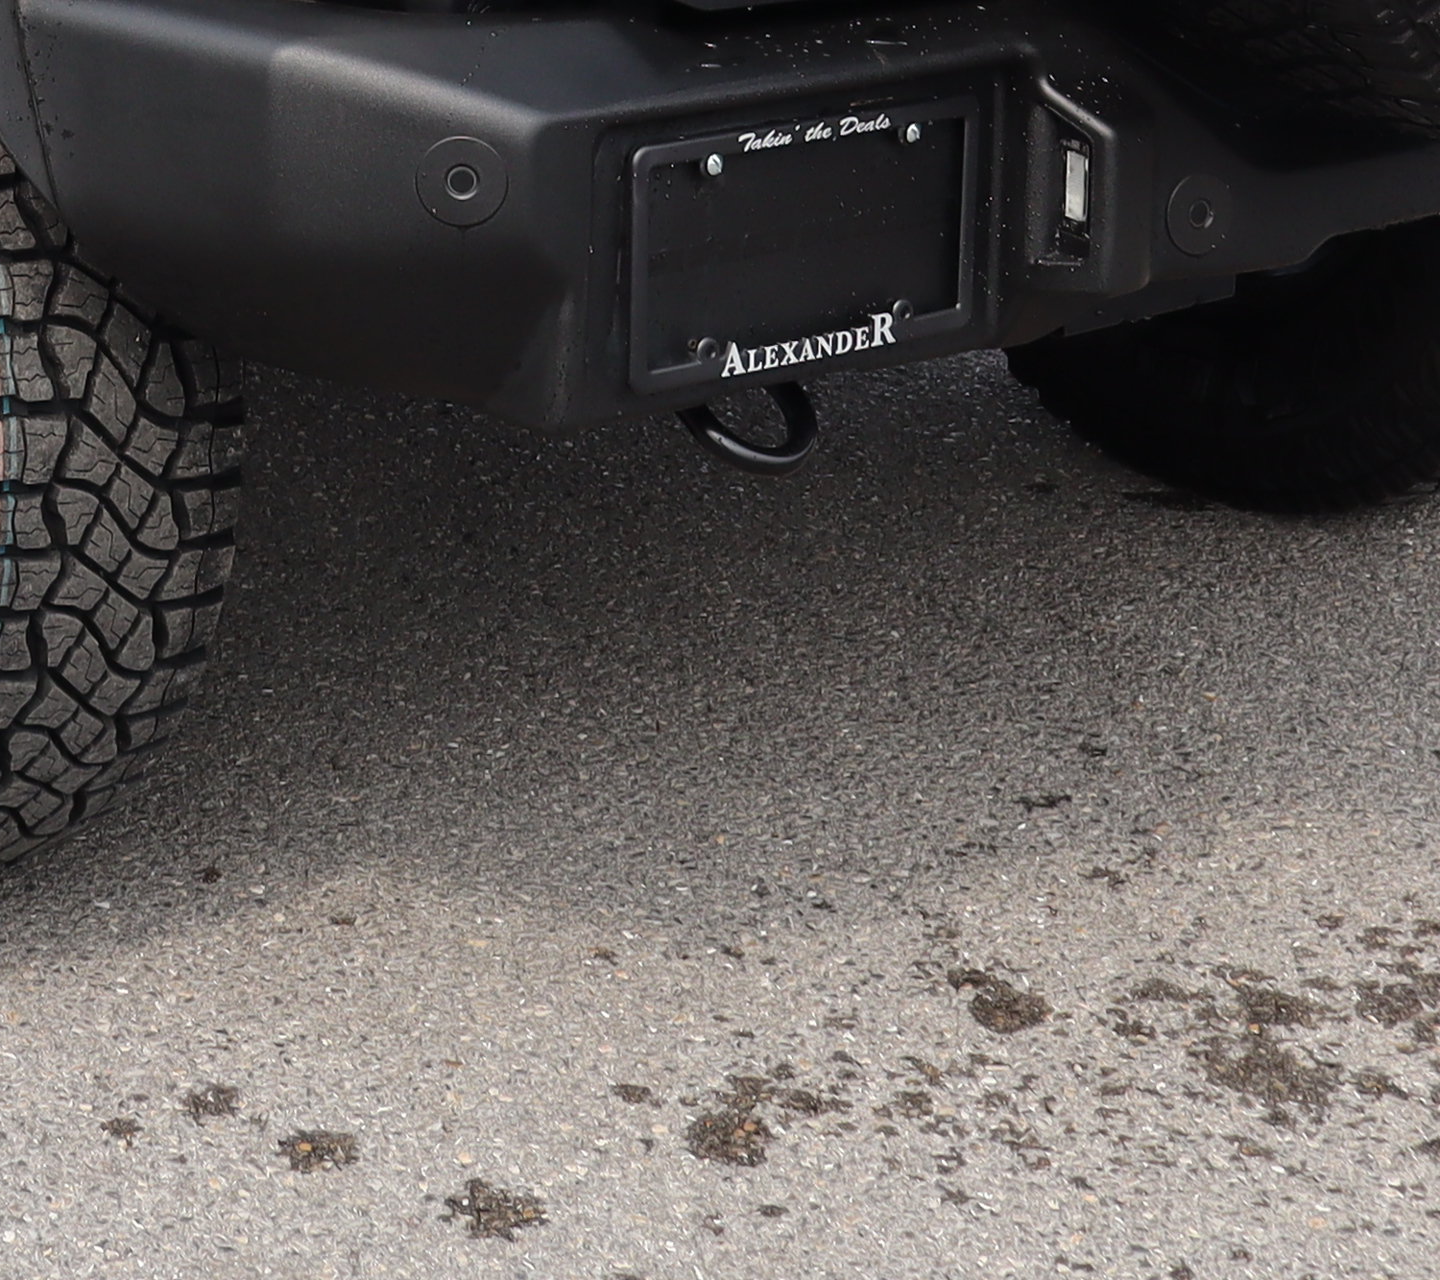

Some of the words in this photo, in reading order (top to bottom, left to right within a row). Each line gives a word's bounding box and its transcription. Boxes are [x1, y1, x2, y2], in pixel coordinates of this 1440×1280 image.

[738, 124, 801, 153] Takin'
[804, 121, 833, 143] the
[839, 113, 892, 137] Deals
[721, 312, 896, 378] ALEXANDER
